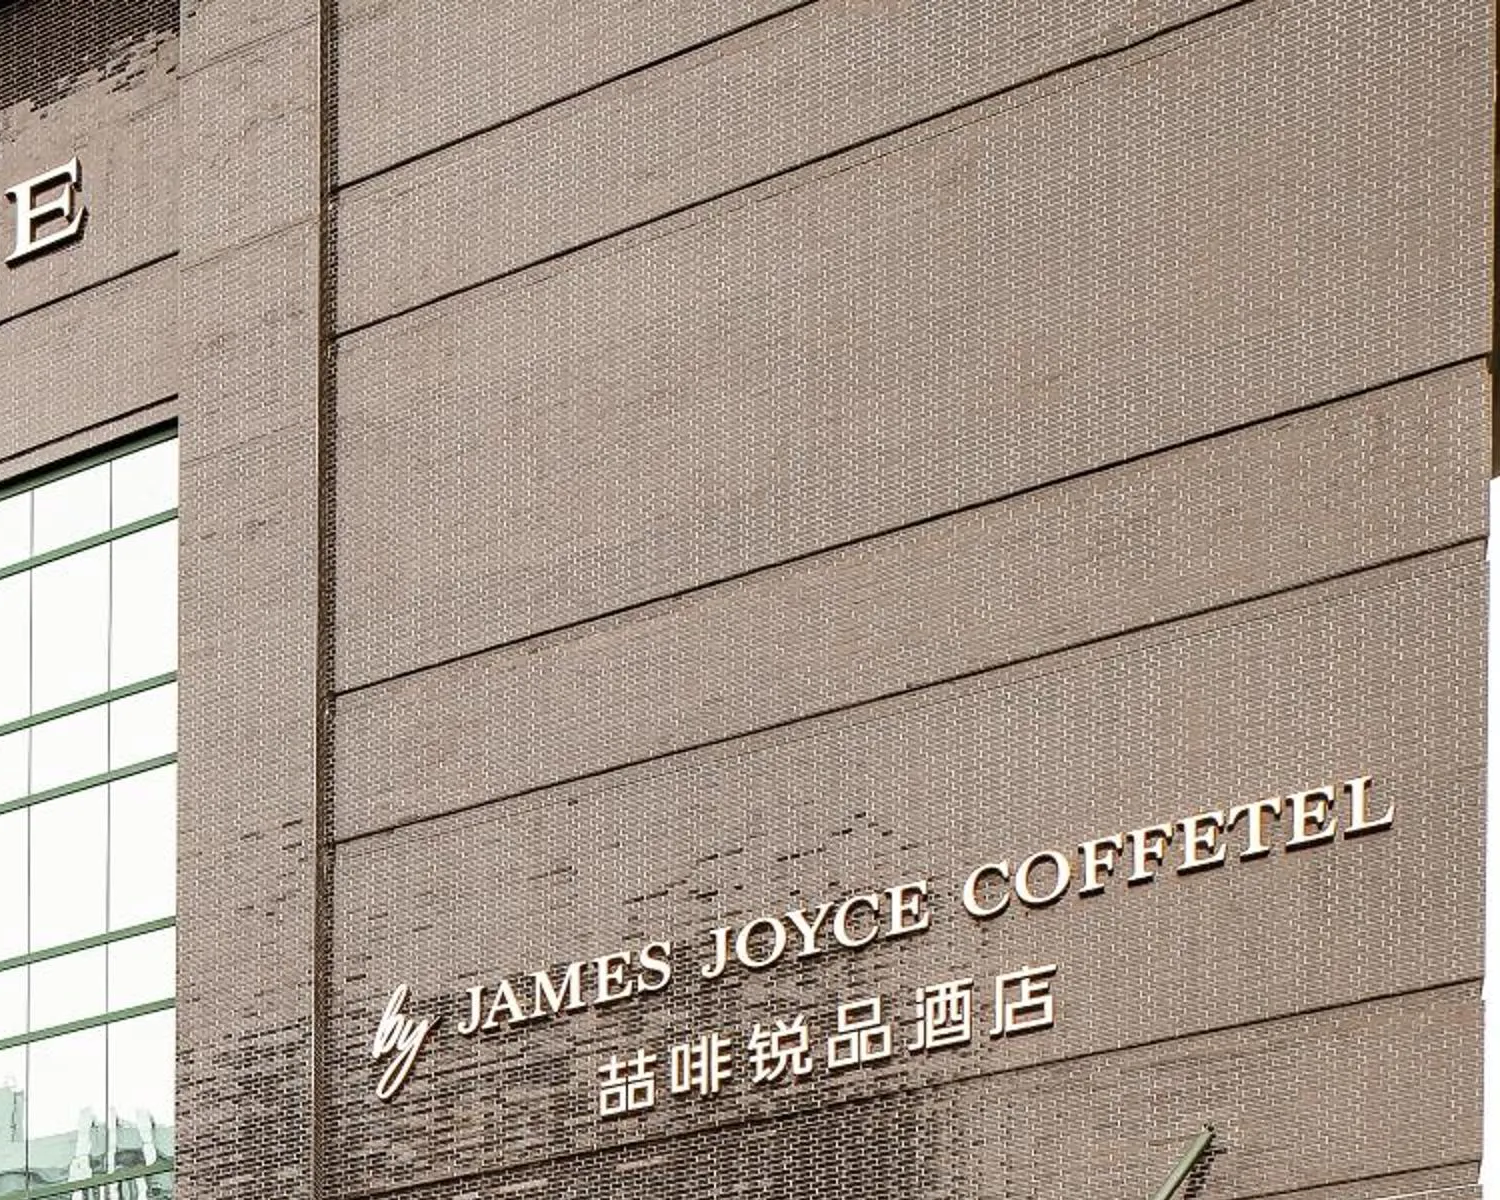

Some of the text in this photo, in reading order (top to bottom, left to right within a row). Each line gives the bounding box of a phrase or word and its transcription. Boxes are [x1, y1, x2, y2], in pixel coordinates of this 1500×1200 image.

[372, 775, 1397, 1101] by JAMES JOYCE COFFETEL
[597, 963, 1058, 1119] 喆啡锐品酒店
